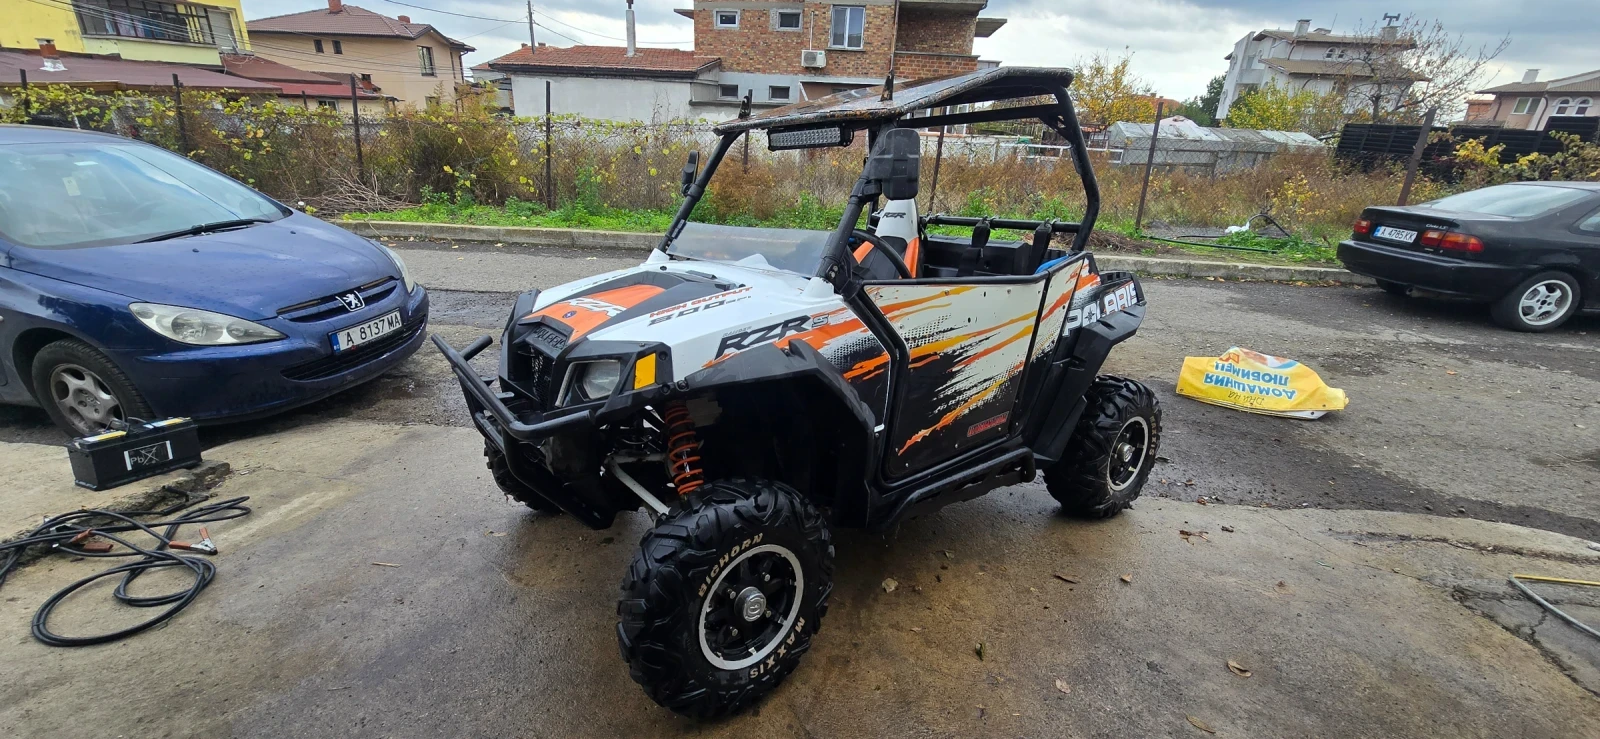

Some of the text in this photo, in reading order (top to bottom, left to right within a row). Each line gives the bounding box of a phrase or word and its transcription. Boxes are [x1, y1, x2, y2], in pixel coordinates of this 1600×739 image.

[1381, 228, 1416, 241] A 4785 KK
[649, 286, 753, 318] HIGH OUTPUT
[1062, 281, 1138, 337] POLARIS
[346, 313, 401, 346] A 8137 MA
[714, 313, 829, 361] RZR S
[1203, 373, 1297, 400] ДОМАШНИЯ
[1214, 361, 1290, 387] ЛЮБИМЕЦ
[1148, 415, 1158, 456] MAXXIS
[130, 456, 145, 465] Pb
[698, 532, 764, 597] BIGHORN
[749, 616, 806, 679] MAXXIS
